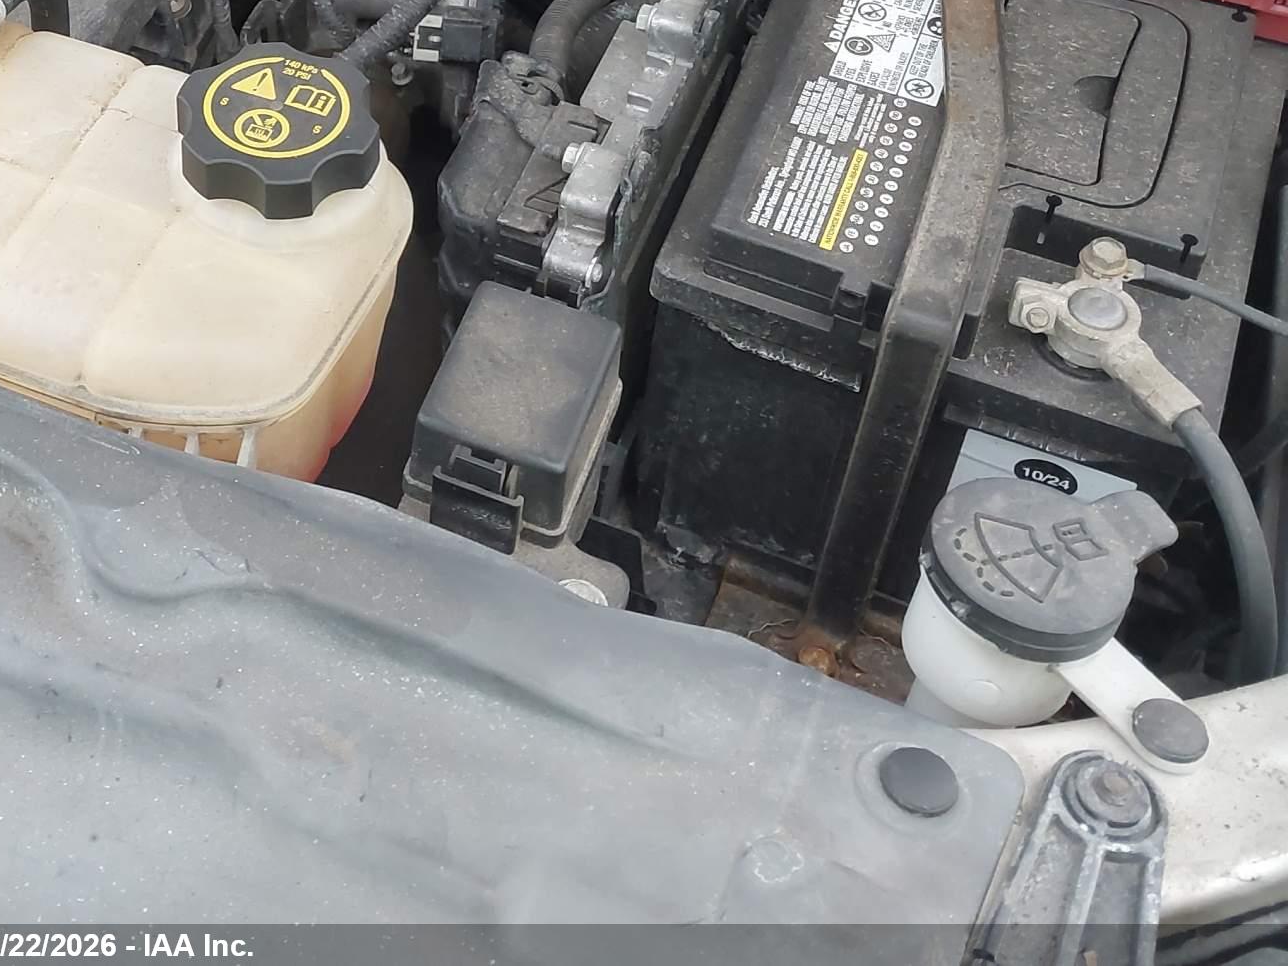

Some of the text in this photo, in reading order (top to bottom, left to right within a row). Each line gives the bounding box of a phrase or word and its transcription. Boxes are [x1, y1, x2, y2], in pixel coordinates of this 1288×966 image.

[283, 59, 301, 69] 140
[281, 67, 312, 81] 20 PSI
[1022, 466, 1071, 492] 10/24
